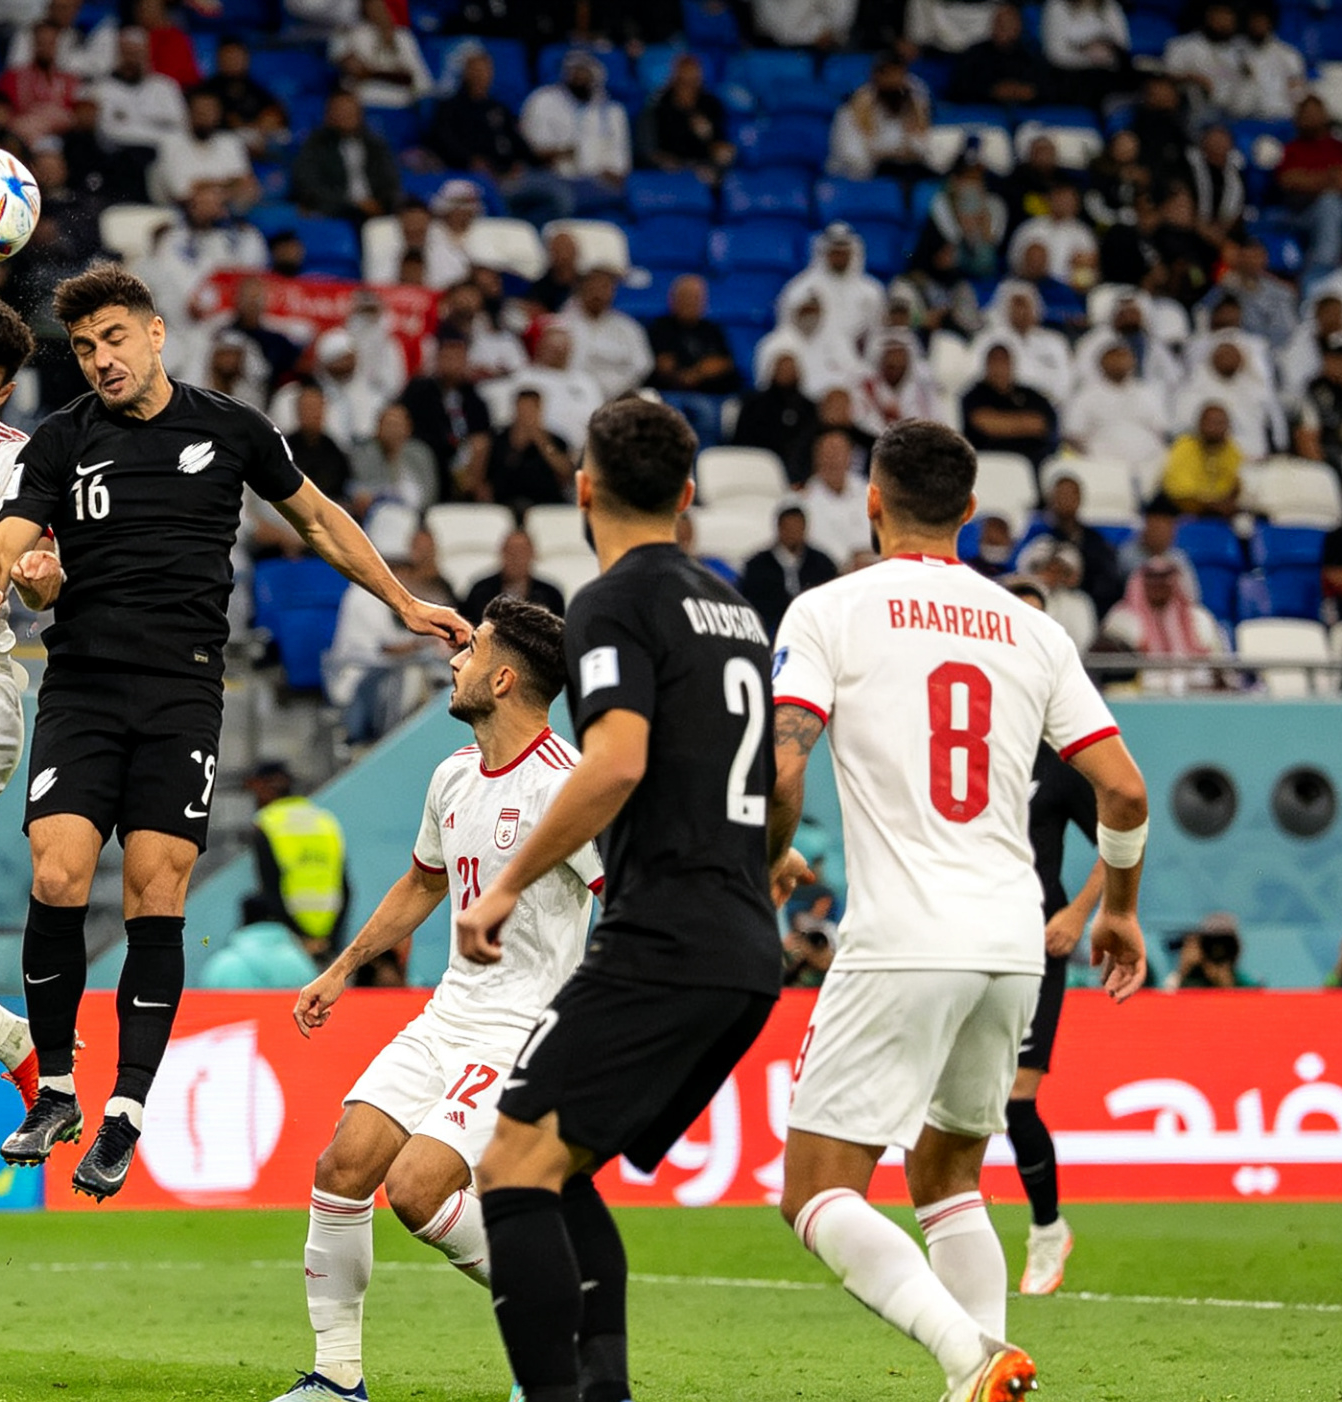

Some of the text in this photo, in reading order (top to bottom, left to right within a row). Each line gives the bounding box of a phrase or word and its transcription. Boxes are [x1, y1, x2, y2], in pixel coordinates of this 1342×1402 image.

[70, 473, 110, 520] 16
[723, 656, 766, 826] 2
[927, 660, 992, 824] 8
[446, 1063, 499, 1109] 12
